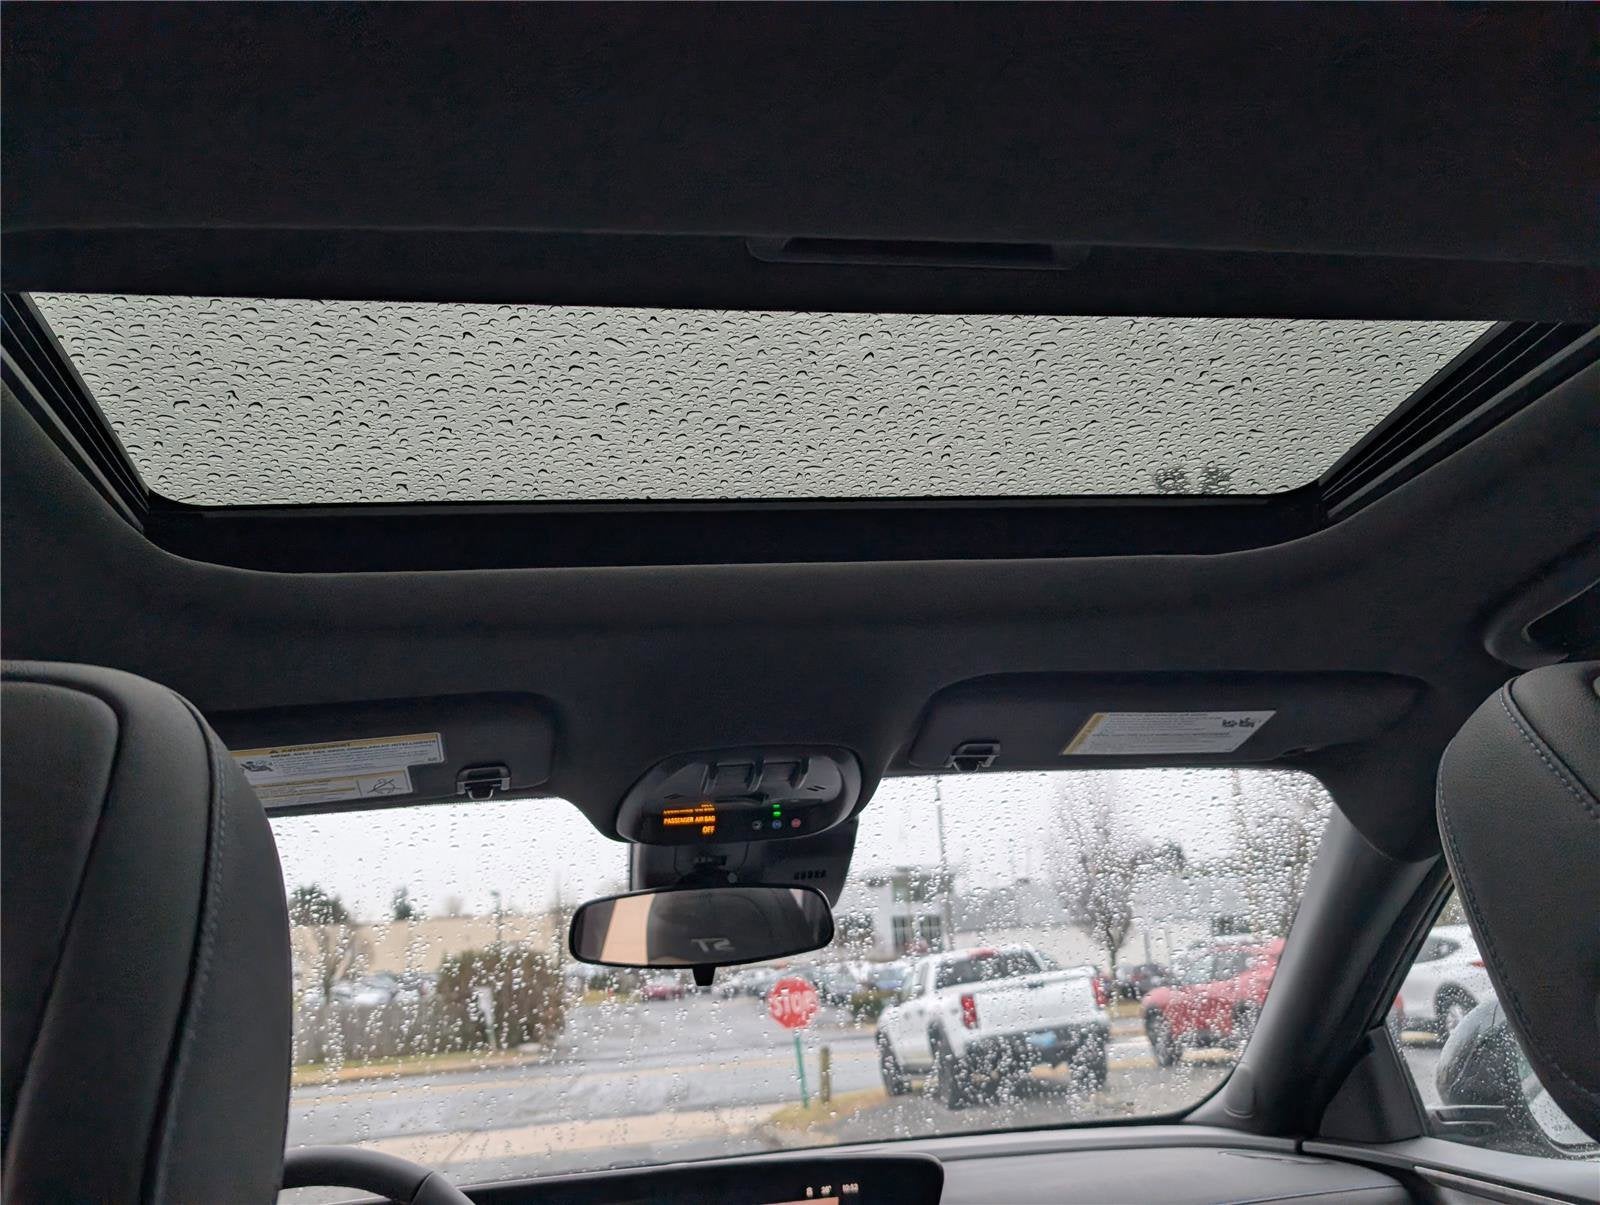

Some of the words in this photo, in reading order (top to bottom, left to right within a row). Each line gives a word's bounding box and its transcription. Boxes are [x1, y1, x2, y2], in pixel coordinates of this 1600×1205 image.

[663, 816, 694, 824] PASSENGER
[702, 825, 715, 835] OFF
[773, 990, 817, 1016] STOP
